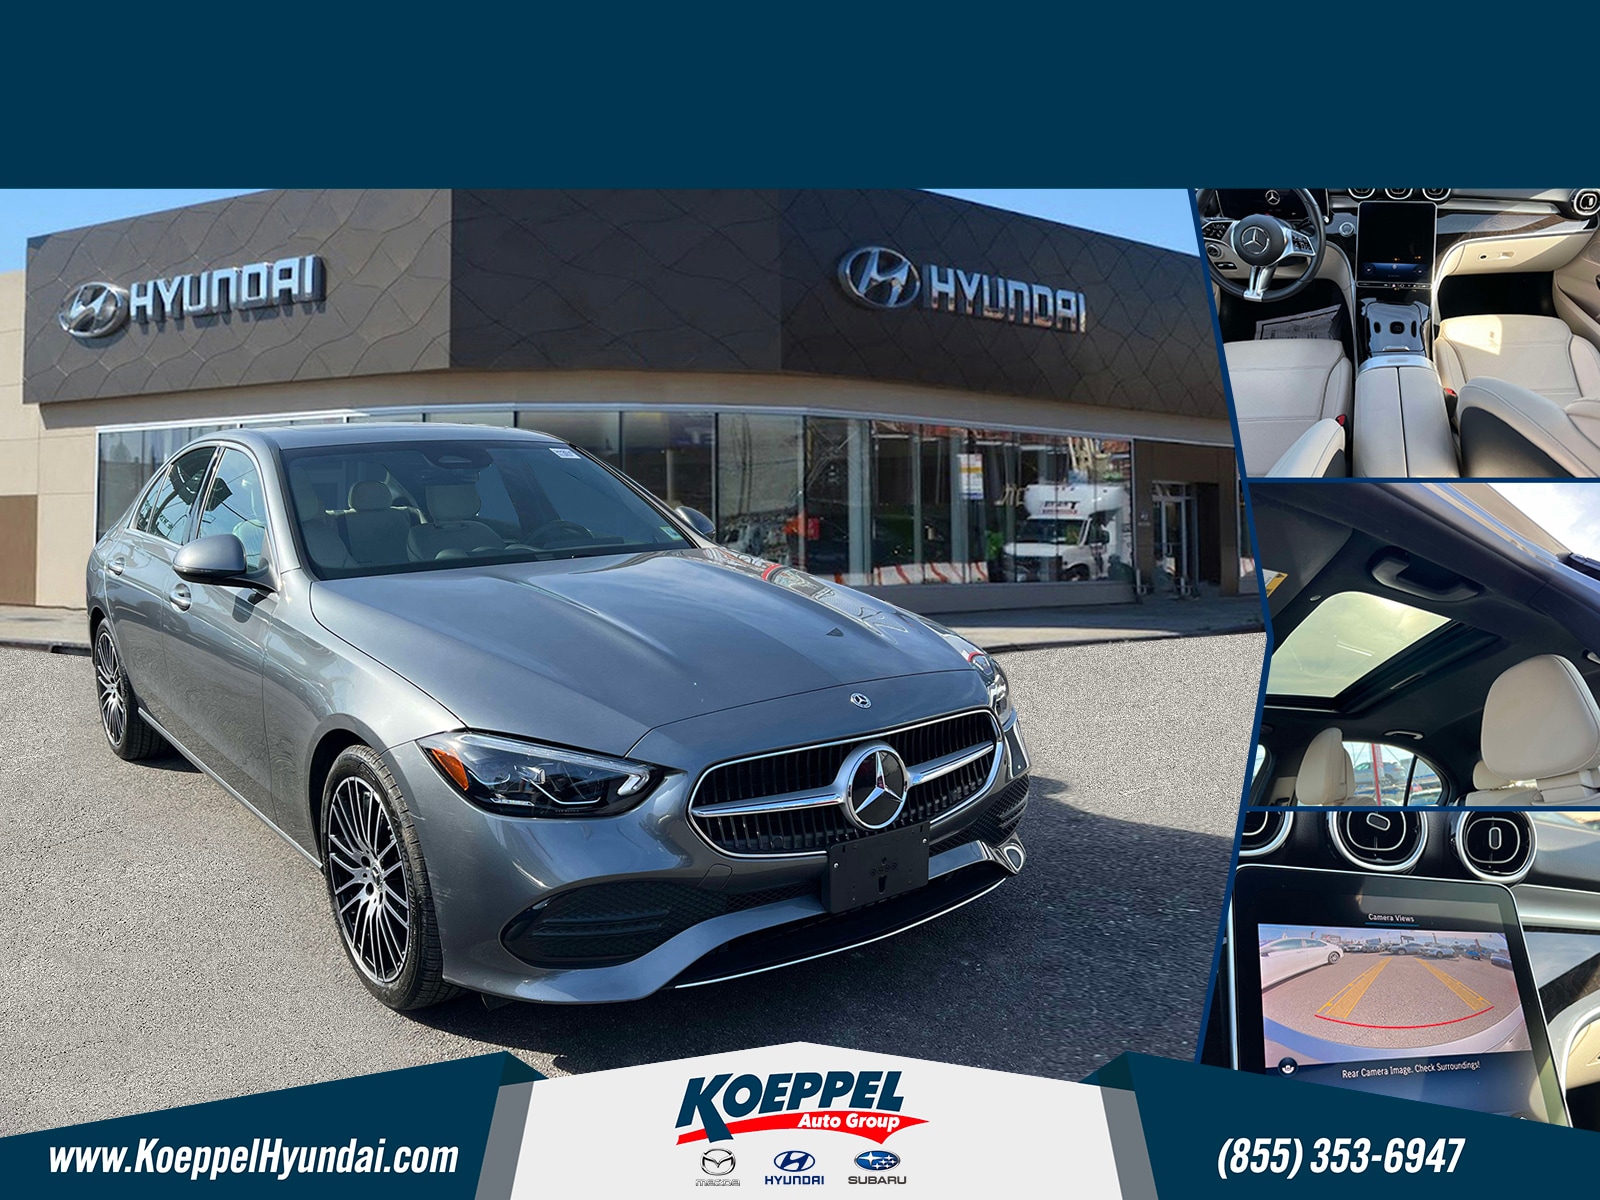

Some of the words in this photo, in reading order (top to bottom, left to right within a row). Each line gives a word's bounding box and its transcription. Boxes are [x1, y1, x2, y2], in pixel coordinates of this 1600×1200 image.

[130, 254, 320, 318] HYUNDAI
[928, 264, 1086, 333] HYUNDAI
[1368, 913, 1394, 921] Camera
[1395, 914, 1415, 922] Views
[1342, 1069, 1360, 1079] Rear
[1361, 1067, 1389, 1078] Camera
[1390, 1066, 1414, 1076] Image.
[1415, 1063, 1436, 1073] Check
[1437, 1060, 1481, 1071] Surroundings!
